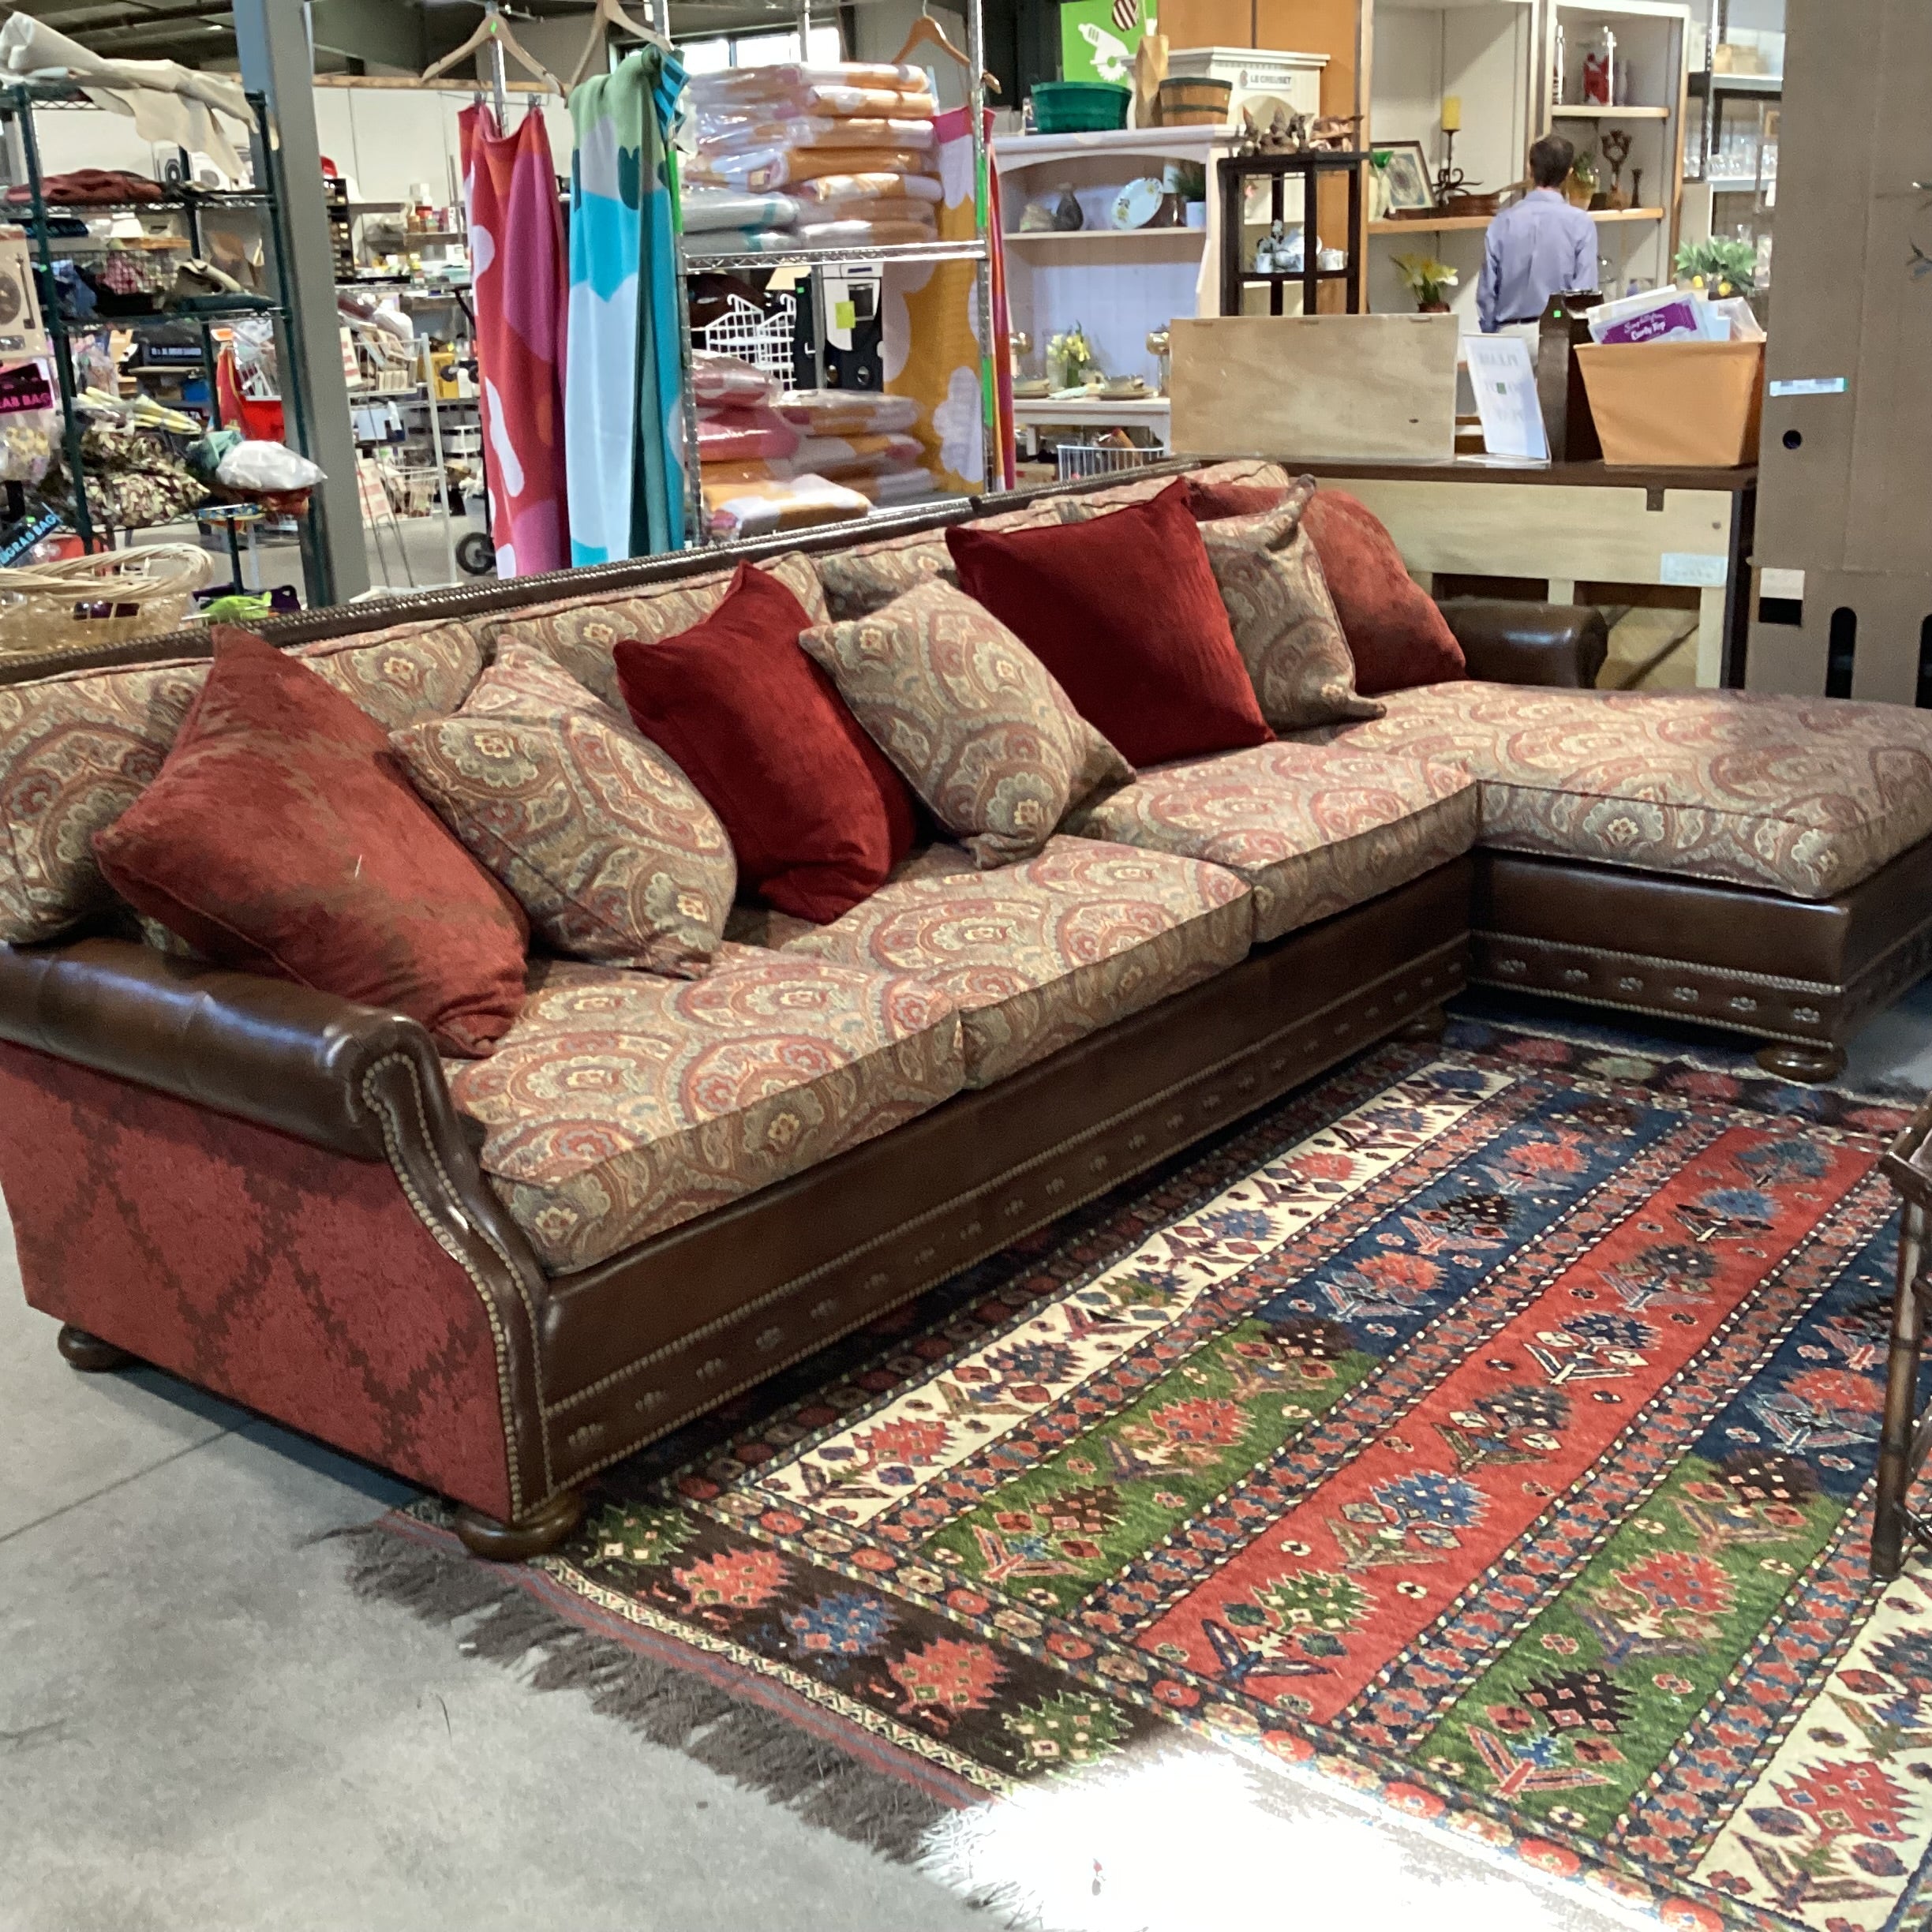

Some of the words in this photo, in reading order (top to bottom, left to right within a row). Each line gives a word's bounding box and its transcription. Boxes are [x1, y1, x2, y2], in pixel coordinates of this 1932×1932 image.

[1260, 76, 1291, 84] CREUSET
[22, 393, 53, 406] BAG
[6, 531, 36, 557] GRAB
[32, 514, 57, 536] BAG
